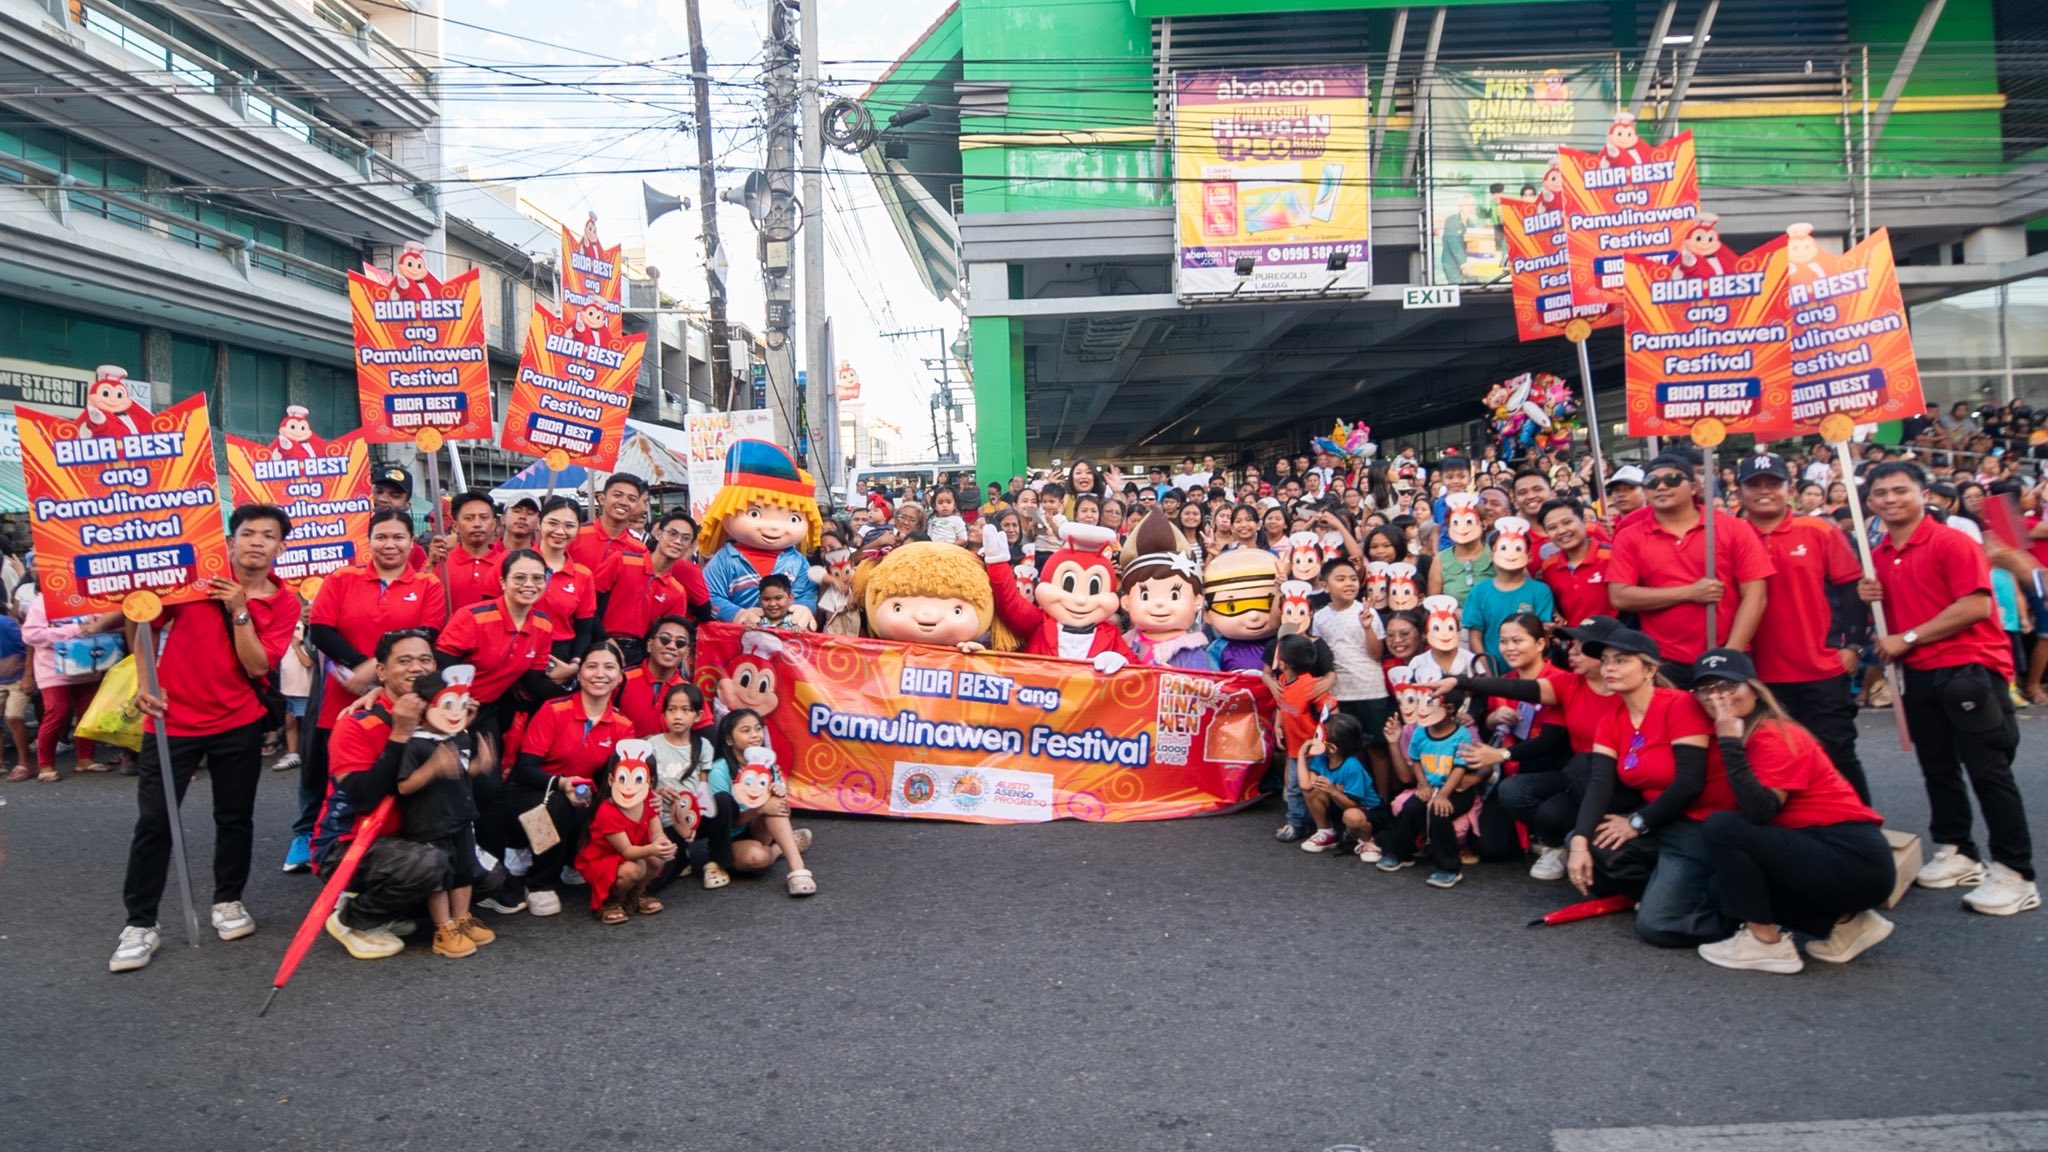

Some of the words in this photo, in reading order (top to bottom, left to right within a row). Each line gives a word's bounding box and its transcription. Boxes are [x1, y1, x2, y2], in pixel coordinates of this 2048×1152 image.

[1217, 76, 1325, 100] abenson
[1211, 115, 1330, 137] HULUGAN
[1584, 168, 1628, 187] BIDA
[1631, 162, 1675, 181] BEST
[1615, 189, 1648, 204] ang
[1524, 210, 1562, 234] BIDA
[1571, 206, 1695, 230] Pamulinawen
[1599, 230, 1670, 250] Festival
[1186, 250, 1222, 259] abenson
[1228, 249, 1263, 257] Personal
[1282, 248, 1310, 261] 0998
[1514, 249, 1568, 274] Pamuli
[572, 253, 591, 272] BIDA
[593, 259, 613, 279] BEST
[1255, 272, 1307, 280] PUREGOLD
[1603, 259, 1624, 274] BID
[585, 278, 600, 293] ang
[1602, 274, 1624, 288] BID
[1651, 279, 1703, 302] BIDA
[1708, 272, 1765, 297] BEST
[1813, 268, 1868, 300] BEST
[1407, 289, 1455, 306] EXIT
[374, 301, 418, 321] BIDA
[421, 299, 464, 320] BEST
[1544, 308, 1570, 323] BIDA
[1572, 303, 1608, 318] PINOY
[1687, 304, 1729, 323] ang
[1796, 305, 1837, 325] ang
[405, 326, 438, 342] ang
[1632, 325, 1786, 352] Pamulinawen
[1792, 315, 1900, 350] ulinawen
[361, 346, 483, 364] Pamulinawen
[546, 335, 583, 359] BIDA
[587, 344, 626, 369] BEST
[1793, 344, 1870, 375] estival
[567, 363, 595, 382] ang
[1666, 351, 1751, 375] Festival
[390, 368, 459, 387] Festival
[522, 368, 627, 407] Pamulinawen
[1829, 375, 1870, 396] BEST
[22, 387, 74, 405] UNION
[1667, 385, 1705, 401] BIDA
[1708, 382, 1749, 399] BEST
[1829, 391, 1878, 412] PINOY
[394, 398, 425, 411] BIDA
[426, 397, 458, 410] BEST
[540, 395, 602, 421] Festival
[1663, 402, 1704, 418] BIDA
[1703, 399, 1753, 416] PINOY
[392, 413, 424, 427] BIDA
[424, 412, 462, 426] PINOY
[536, 418, 565, 435] BIDA
[566, 424, 594, 441] BEST
[55, 438, 117, 464] BIDA
[122, 432, 184, 461] BEST
[530, 430, 560, 447] BIDA
[559, 436, 593, 454] PINOY
[102, 466, 149, 488] ang
[255, 460, 301, 480] BIDA
[303, 456, 349, 477] BEST
[287, 482, 322, 499] ang
[37, 485, 214, 521] Pamulinawen
[284, 498, 370, 518] ulinawen
[81, 515, 182, 546] Festival
[88, 555, 134, 576] BIDA
[136, 550, 181, 571] BEST
[311, 545, 344, 561] BEST
[87, 574, 132, 595] BIDA
[134, 567, 188, 590] PINOY
[900, 667, 952, 695] BIDA
[957, 674, 1015, 703] BEST
[1018, 688, 1059, 709] ang
[810, 706, 1023, 753] Pamulinawen
[1030, 725, 1149, 766] Festival
[1157, 744, 1187, 755] Laoag
[993, 796, 1047, 808] PROGRESO
[994, 789, 1034, 798] ASENSO
